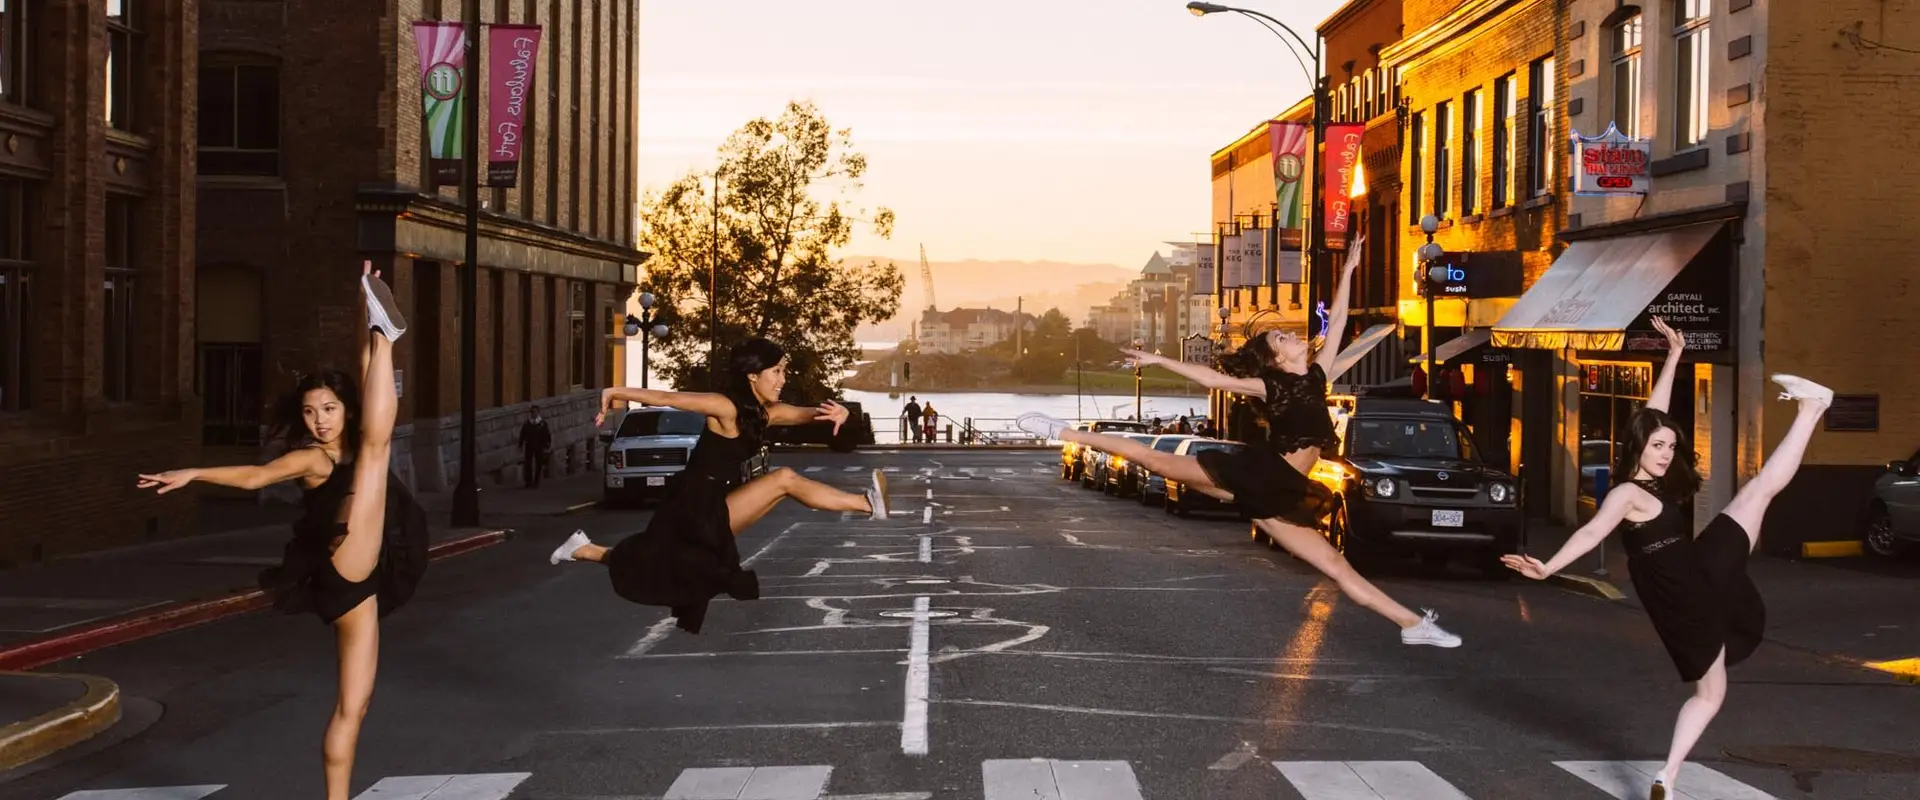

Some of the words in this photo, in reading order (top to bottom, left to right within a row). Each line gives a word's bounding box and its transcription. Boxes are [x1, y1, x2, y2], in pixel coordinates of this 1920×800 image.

[1599, 177, 1631, 187] OPEN
[1445, 285, 1467, 293] sushi
[1648, 302, 1704, 314] architect
[1187, 345, 1209, 353] THE
[1187, 354, 1209, 363] KEG
[1481, 352, 1510, 362] sushi
